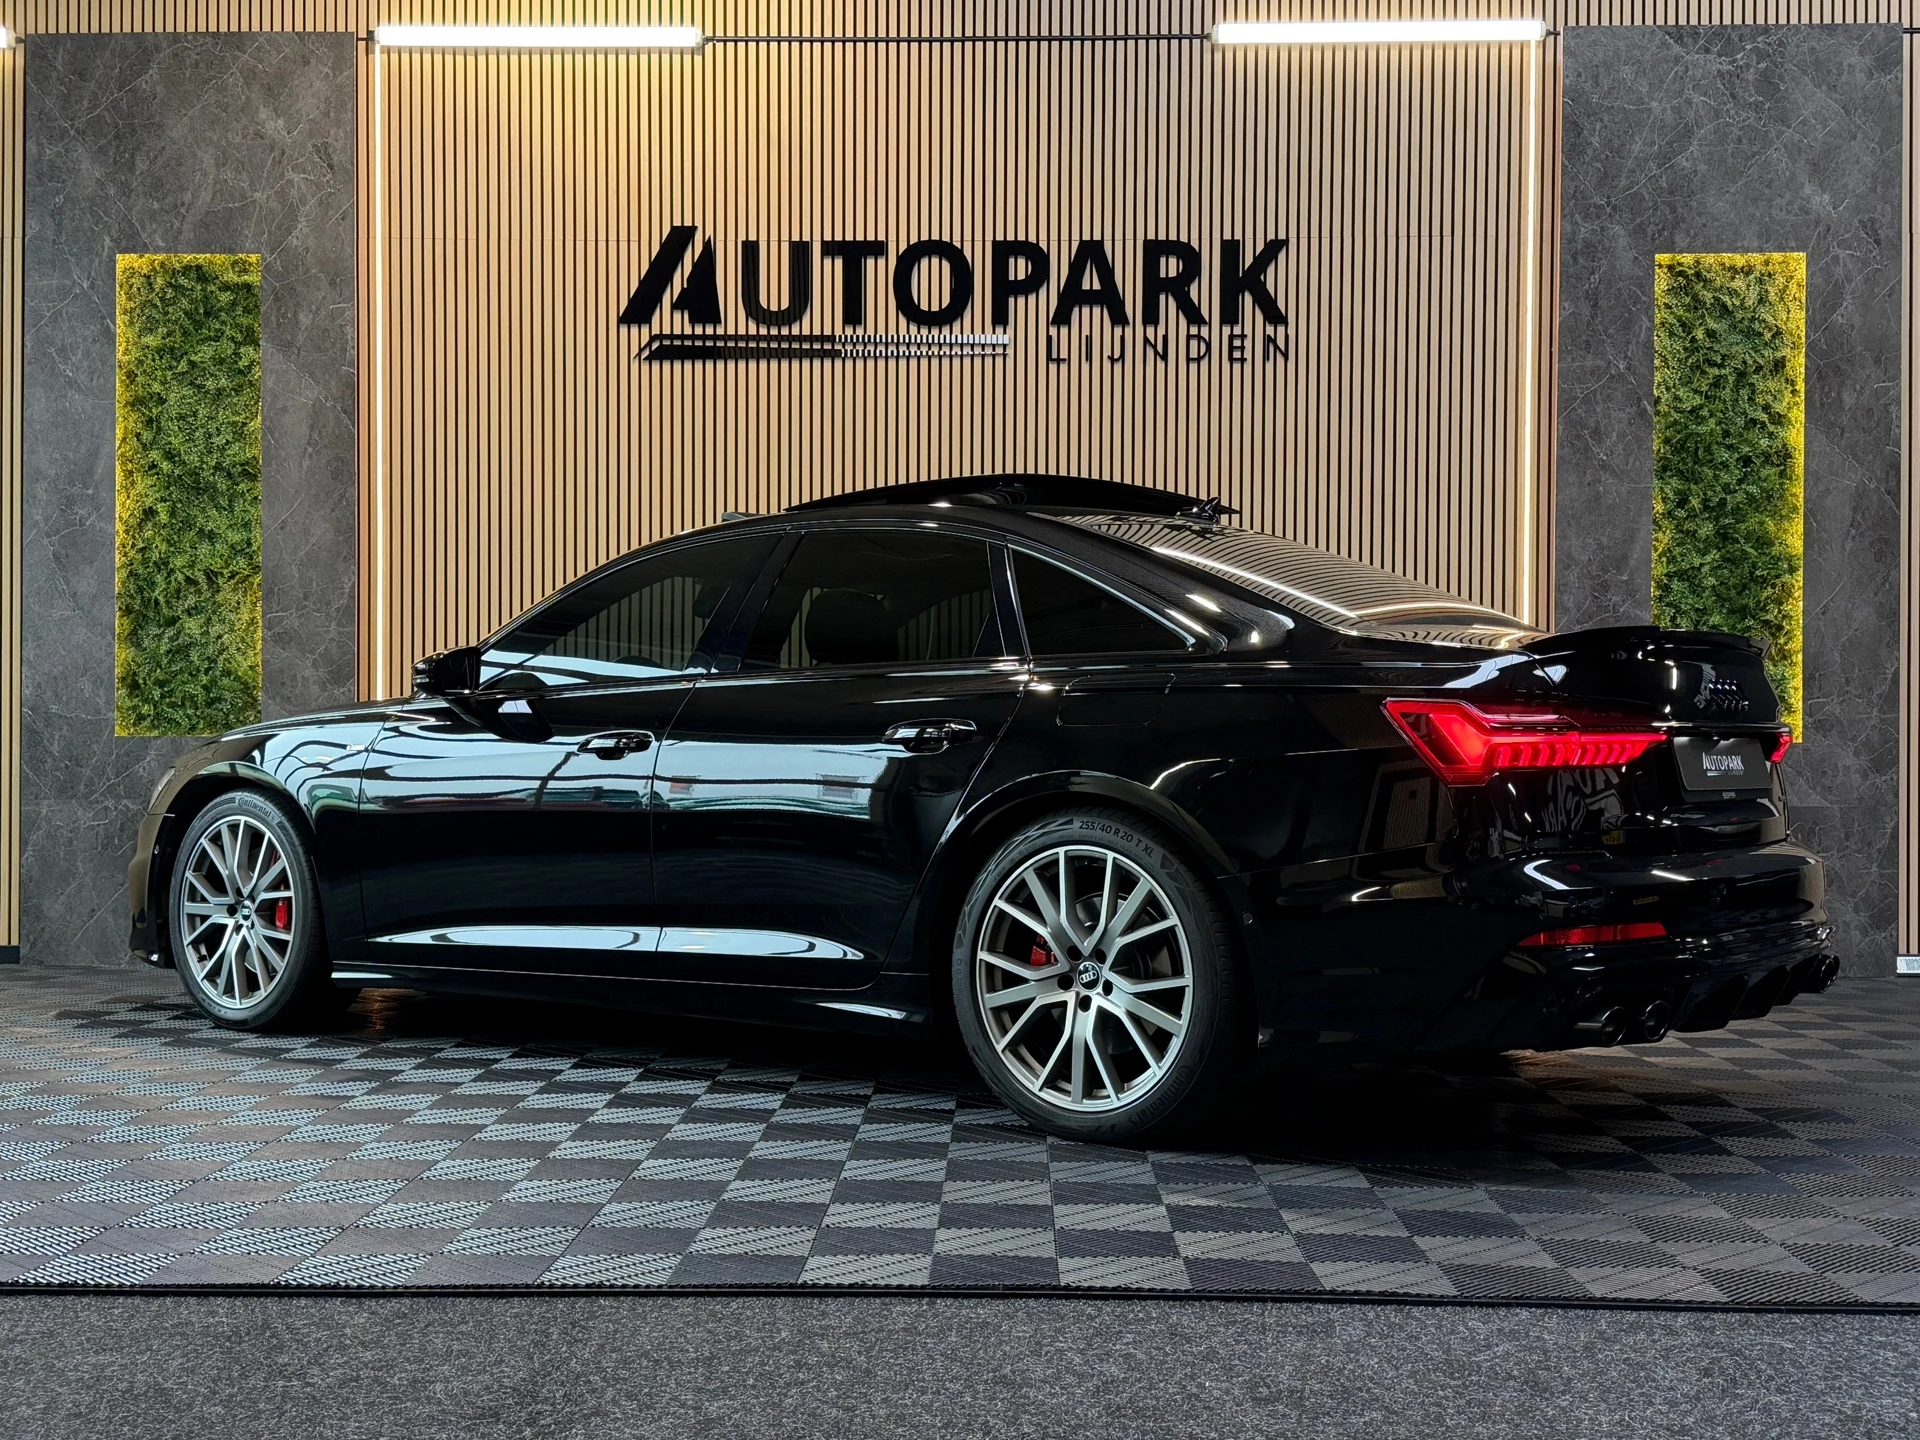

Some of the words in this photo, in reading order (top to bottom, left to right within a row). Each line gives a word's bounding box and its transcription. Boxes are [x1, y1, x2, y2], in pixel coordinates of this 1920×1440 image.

[618, 225, 1289, 326] AUTOPARK
[1048, 334, 1290, 365] LIJNDEN
[1702, 752, 1745, 770] AUTOPARK
[238, 797, 272, 818] Continental
[1079, 820, 1112, 834] 255/40
[1113, 827, 1120, 837] R
[1120, 831, 1133, 843] 20
[1135, 838, 1143, 848] T
[1142, 843, 1154, 858] XL
